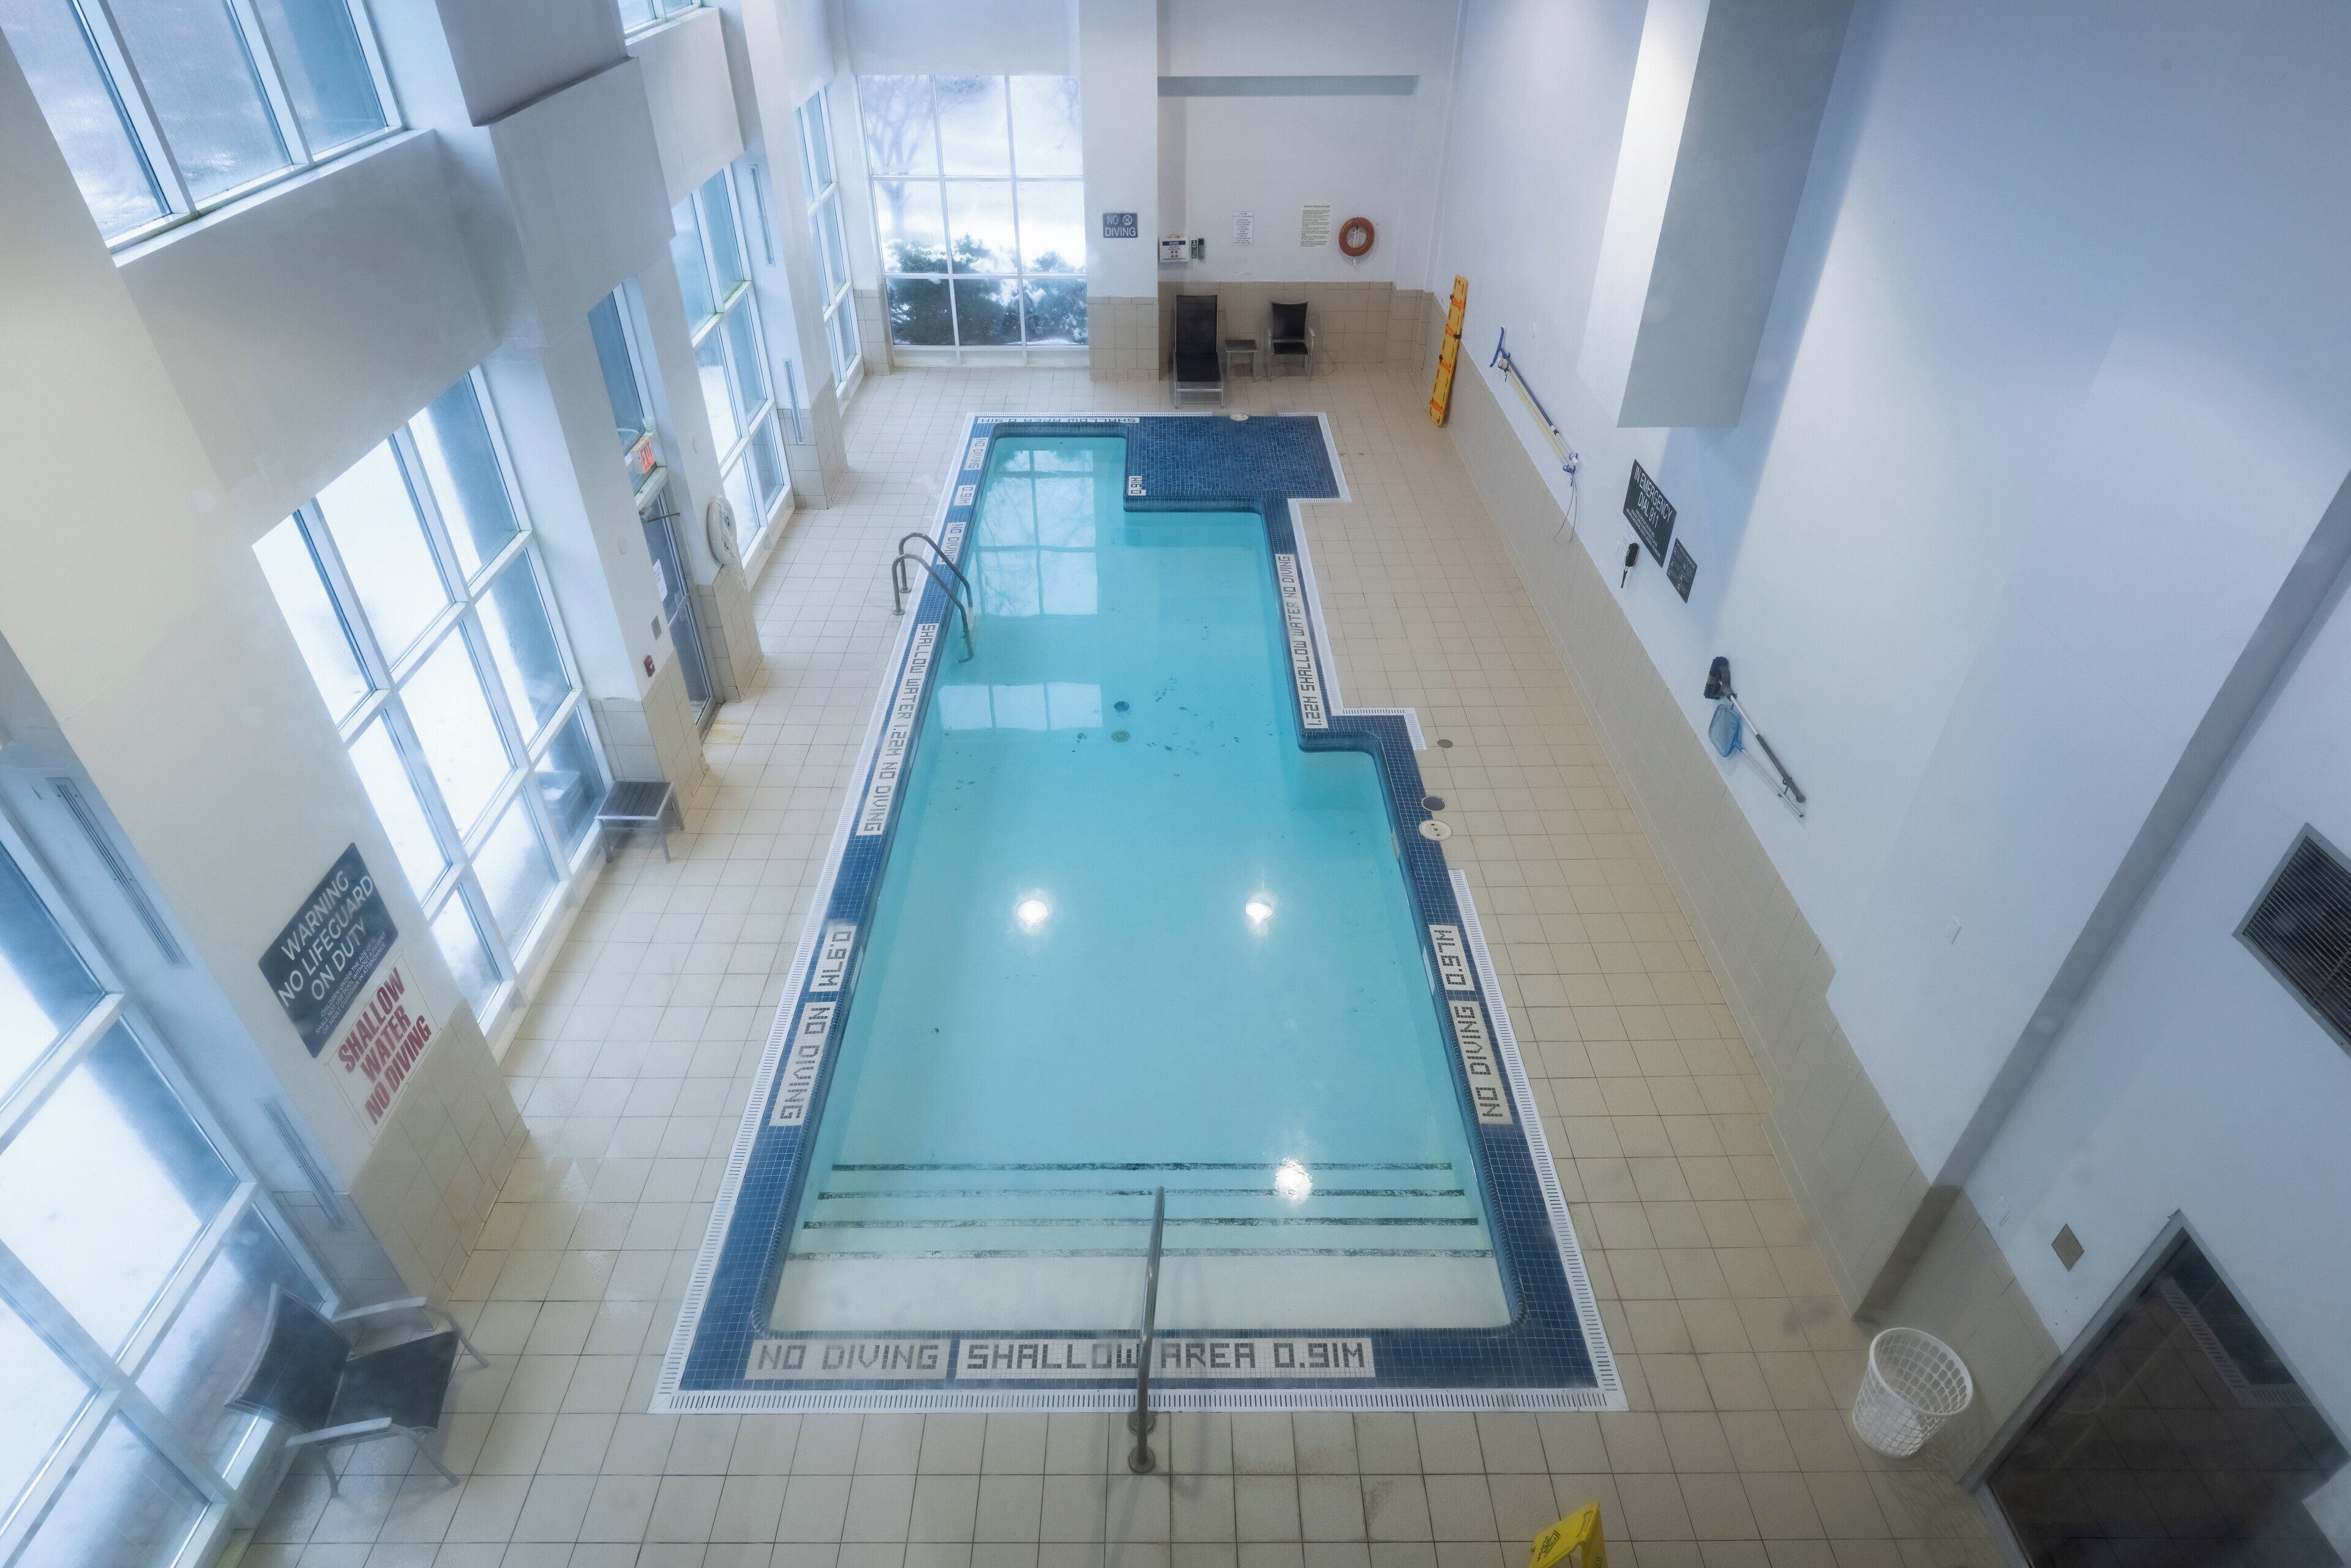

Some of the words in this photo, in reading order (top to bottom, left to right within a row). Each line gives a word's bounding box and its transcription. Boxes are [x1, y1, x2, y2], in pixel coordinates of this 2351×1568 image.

[1104, 227, 1136, 236] DIVING
[1107, 215, 1119, 225] NO
[640, 441, 654, 471] EXIT
[968, 449, 983, 468] DIVING
[975, 438, 986, 447] NO
[958, 487, 973, 504] 0.91M
[1131, 478, 1142, 494] 0.91M
[1633, 465, 1641, 483] IN
[1639, 472, 1673, 523] EMERGENCY
[1638, 491, 1650, 517] DIAL
[1649, 507, 1659, 528] 911
[950, 523, 964, 534] NO
[1278, 556, 1295, 583] DIVING
[1283, 587, 1297, 598] NO
[1286, 602, 1305, 636] WATER
[910, 625, 936, 673] SHALLOW
[1292, 640, 1315, 691] SHALLOW
[896, 678, 921, 719] WATER
[1302, 697, 1322, 725] 1.22M
[885, 725, 909, 756] 1.22M
[879, 762, 898, 779] NO
[863, 786, 892, 831] DIVING
[280, 870, 349, 961] WARNING
[278, 970, 304, 1007] NO
[301, 875, 373, 977] LIFEGUARD
[311, 964, 336, 1000] ON
[331, 915, 367, 973] DUTY
[315, 1017, 329, 1035] SHALL
[328, 1005, 336, 1018] NOT
[336, 993, 344, 1005] USE
[343, 980, 354, 995] POOL
[353, 955, 370, 980] WITHOUT
[372, 931, 387, 952] PARENT
[320, 988, 340, 1017] CHILDREN
[339, 970, 353, 991] UNDER
[351, 960, 360, 972] THE
[359, 950, 367, 962] AGE
[322, 1025, 329, 1034] OR
[328, 1006, 342, 1027] ADULT
[340, 980, 360, 1008] GUARDIAN
[362, 942, 386, 976] ATTENDANCE
[337, 966, 405, 1073] SHALLOW
[804, 1007, 831, 1035] NO
[360, 1004, 412, 1085] WATER
[1454, 1006, 1491, 1076] DIVING
[364, 1081, 391, 1125] NO
[384, 1015, 432, 1094] DIVING
[779, 1045, 820, 1119] DIVING
[1475, 1087, 1503, 1117] NO
[757, 1345, 807, 1370] NO
[822, 1344, 939, 1370] DIVING
[967, 1343, 1139, 1369] SHALLOW
[1161, 1343, 1256, 1368] AREA
[1273, 1342, 1365, 1368] 0.91M
